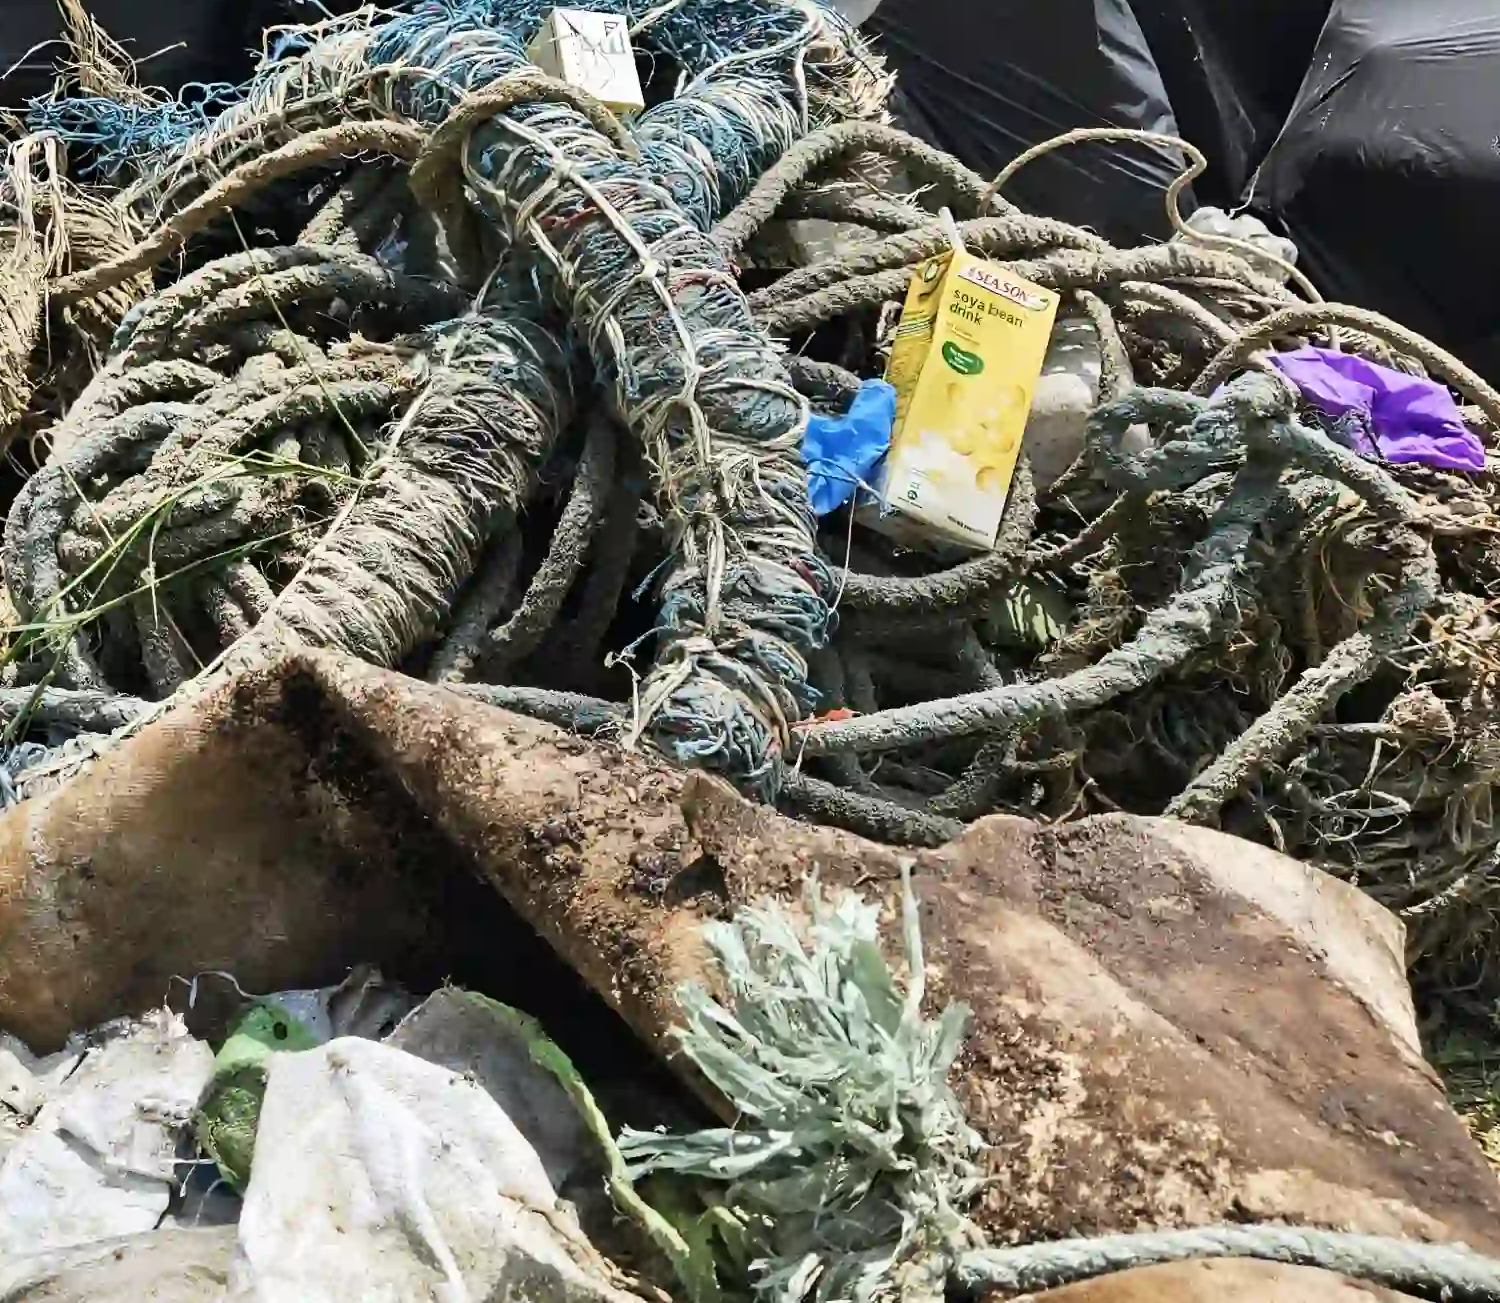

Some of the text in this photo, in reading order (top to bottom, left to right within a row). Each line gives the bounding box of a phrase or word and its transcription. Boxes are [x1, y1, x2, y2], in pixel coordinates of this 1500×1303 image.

[949, 302, 983, 326] drink
[953, 289, 1024, 328] soya bean
